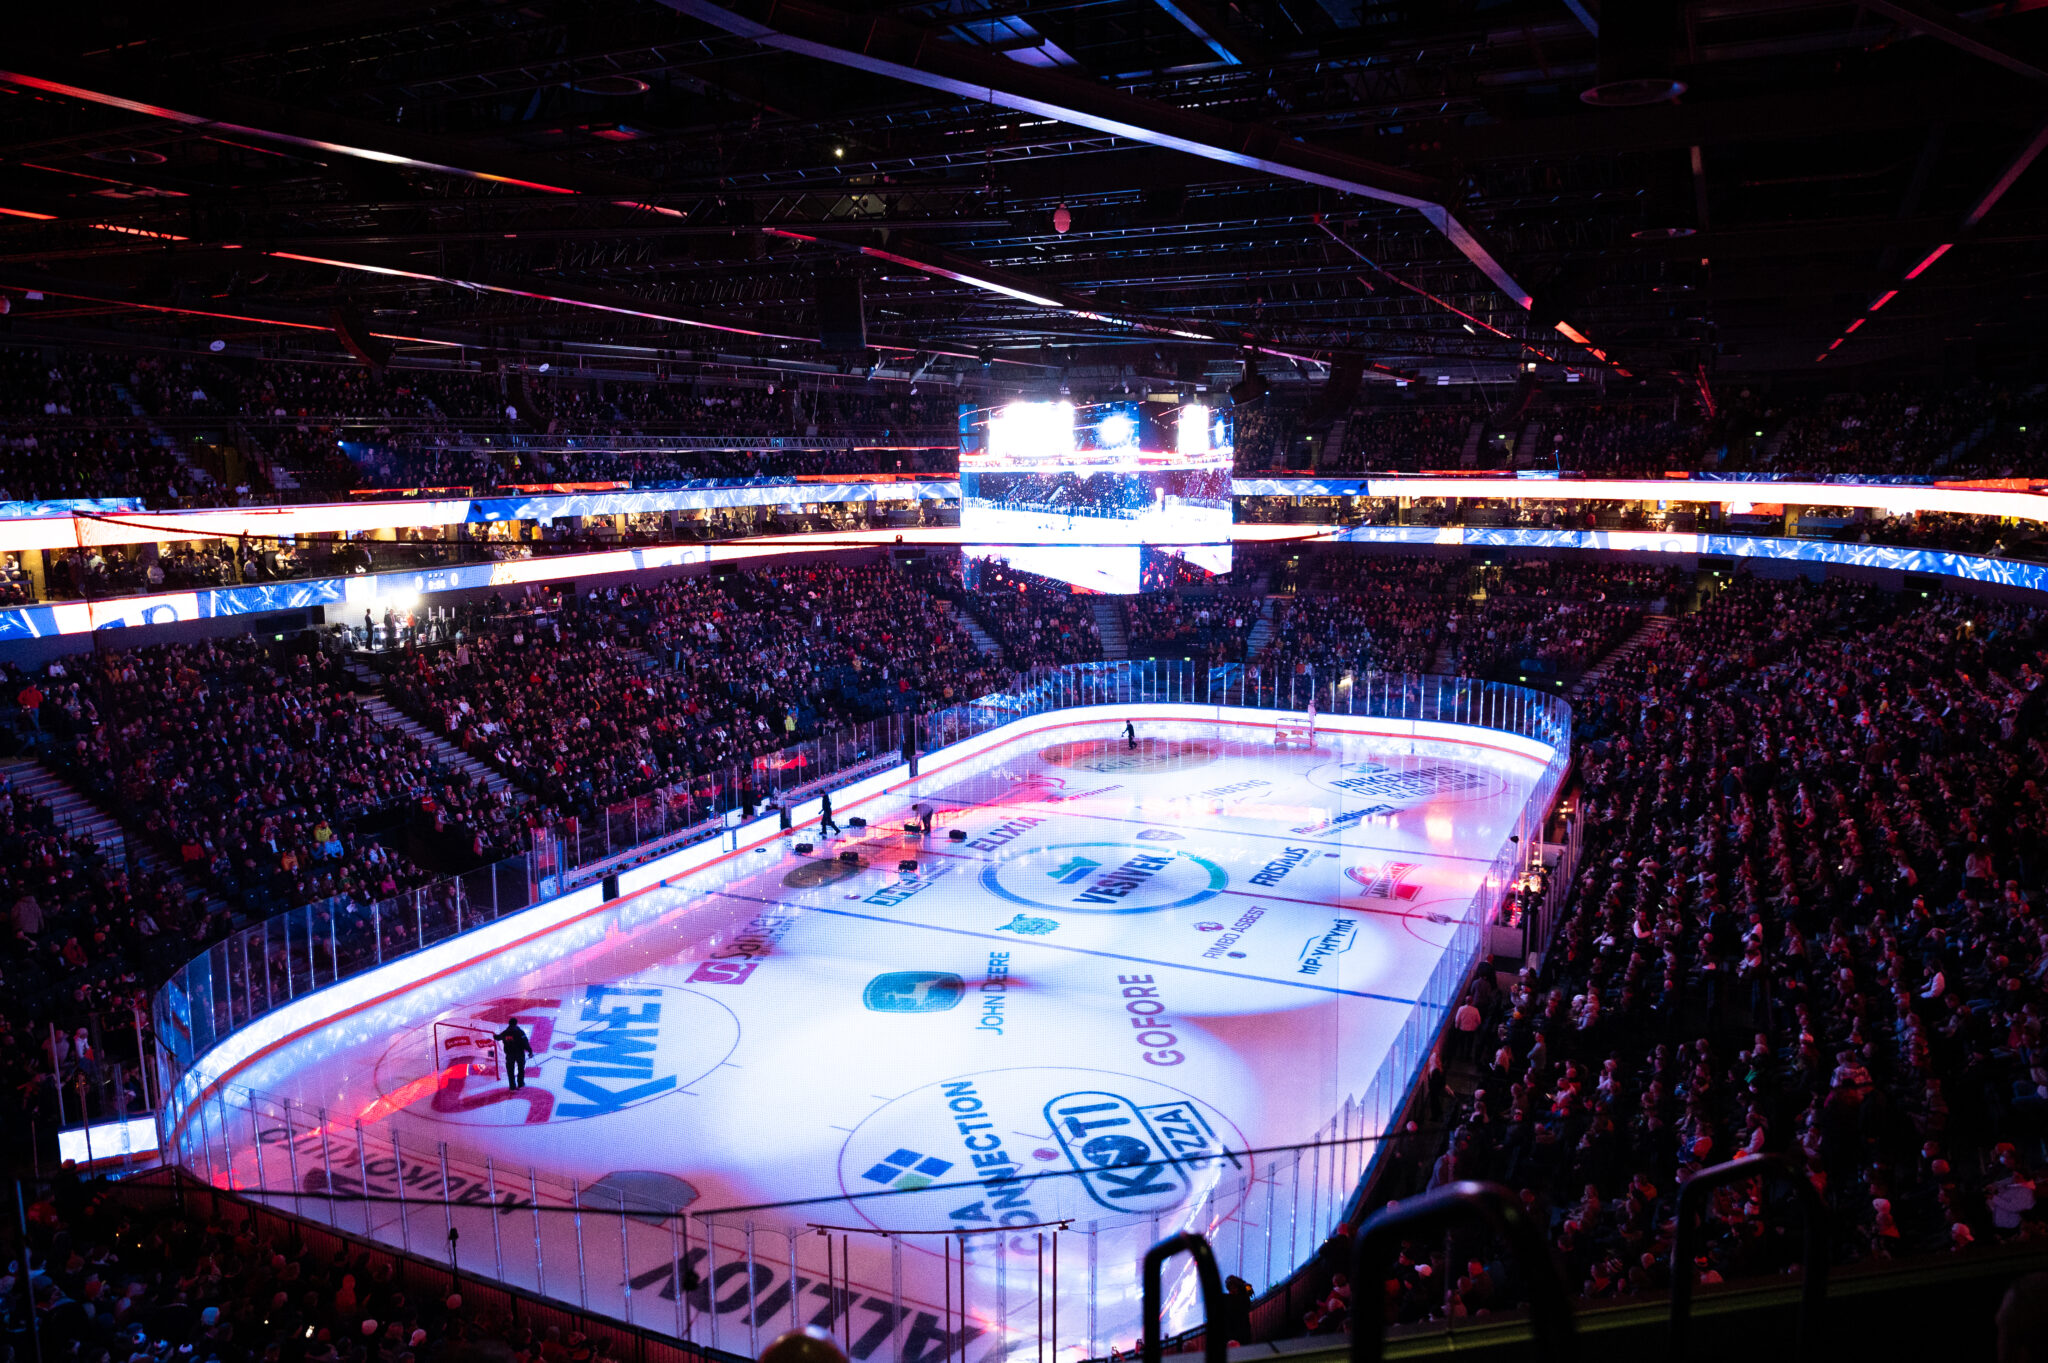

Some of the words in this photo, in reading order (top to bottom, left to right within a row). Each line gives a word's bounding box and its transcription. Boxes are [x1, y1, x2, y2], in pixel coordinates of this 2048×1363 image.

[1072, 854, 1176, 904] VESIVEK
[1202, 932, 1241, 960] RIMBO
[1231, 905, 1268, 933] ASBEST
[980, 951, 1010, 992] DEERE
[975, 995, 1006, 1036] JOHN
[1117, 972, 1186, 1067] GOFORE
[940, 1080, 1051, 1256] CONNECTION
[1058, 1101, 1178, 1199] KOTI
[1151, 1108, 1211, 1170] PIZZA
